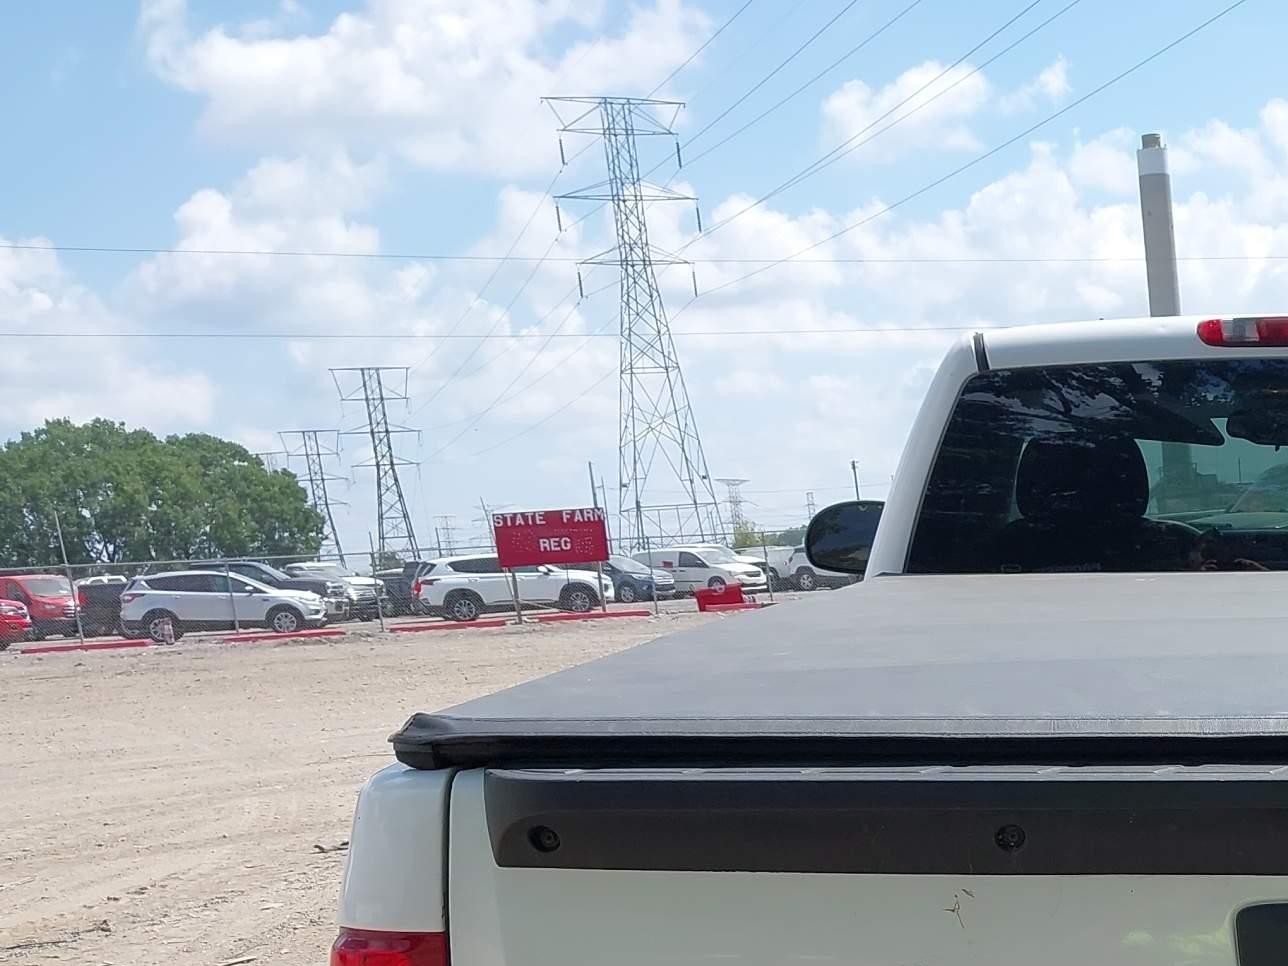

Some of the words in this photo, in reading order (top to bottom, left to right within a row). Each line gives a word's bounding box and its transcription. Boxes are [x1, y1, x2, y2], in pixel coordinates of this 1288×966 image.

[493, 511, 546, 527] STATE
[562, 507, 605, 523] FARM
[539, 537, 571, 552] REG
